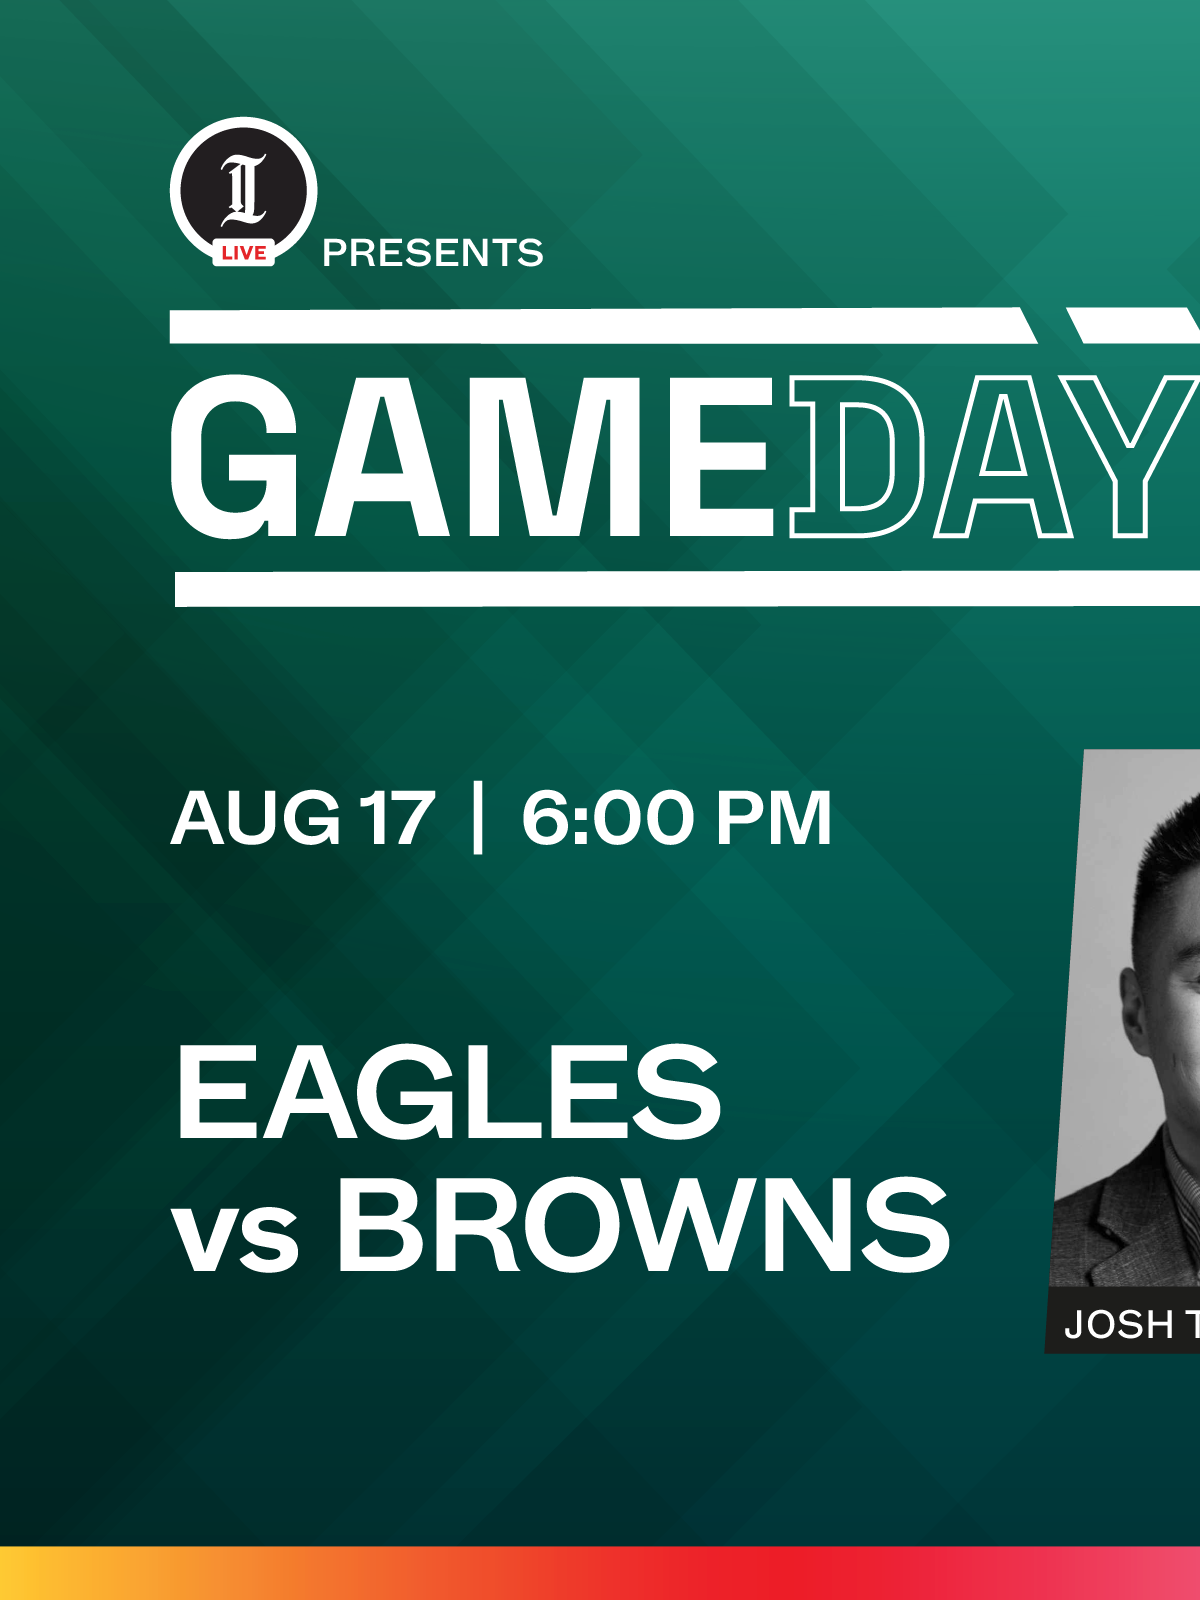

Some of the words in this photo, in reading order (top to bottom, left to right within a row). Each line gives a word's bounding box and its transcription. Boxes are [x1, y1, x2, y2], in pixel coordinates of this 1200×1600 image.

[221, 245, 268, 261] LIVE
[323, 238, 544, 267] PRESENTS
[169, 788, 339, 847] AUG
[360, 789, 437, 846] 17
[522, 788, 695, 847] 6:00
[717, 789, 831, 846] PM
[179, 1042, 722, 1142] EAGLES
[170, 1205, 299, 1275] vs
[339, 1175, 951, 1275] BROWNS
[1064, 1308, 1174, 1340] JOSH
